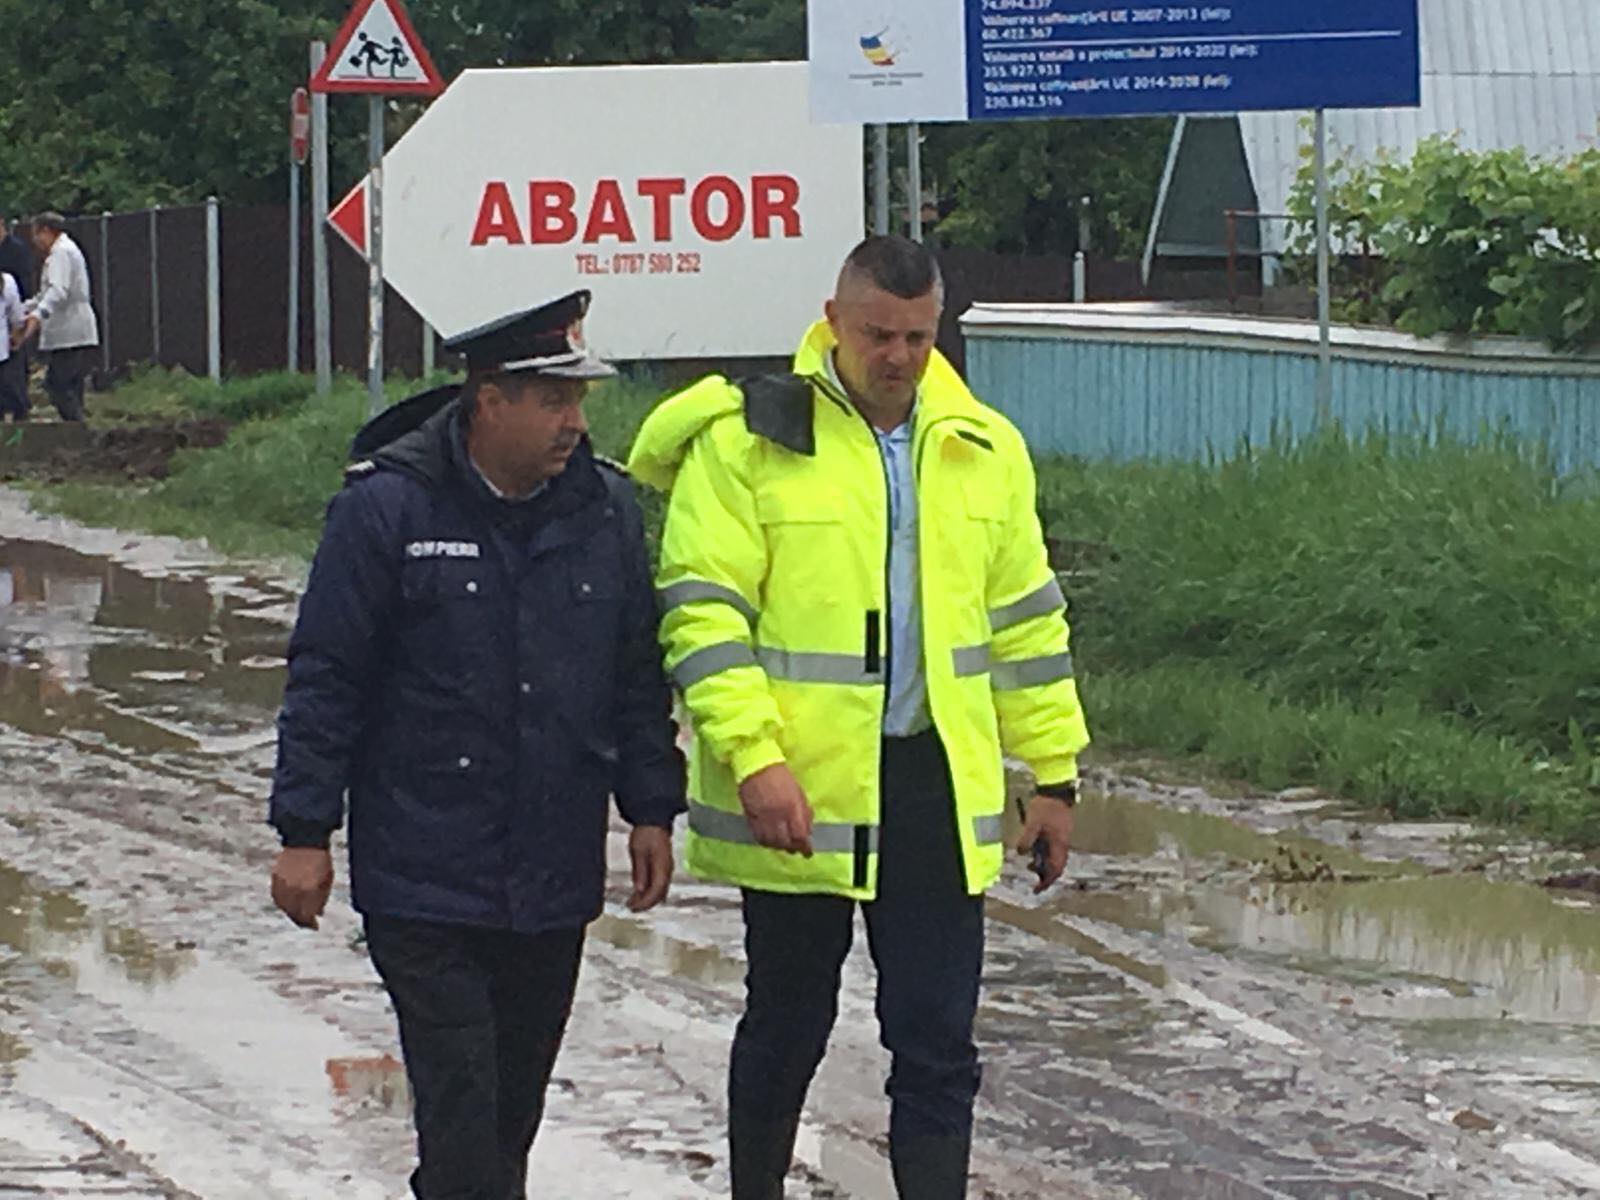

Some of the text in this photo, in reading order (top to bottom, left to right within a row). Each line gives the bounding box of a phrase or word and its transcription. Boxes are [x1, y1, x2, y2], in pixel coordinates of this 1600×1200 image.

[1111, 9, 1128, 22] UE
[1112, 76, 1130, 90] UE
[470, 175, 803, 246] ABATOR
